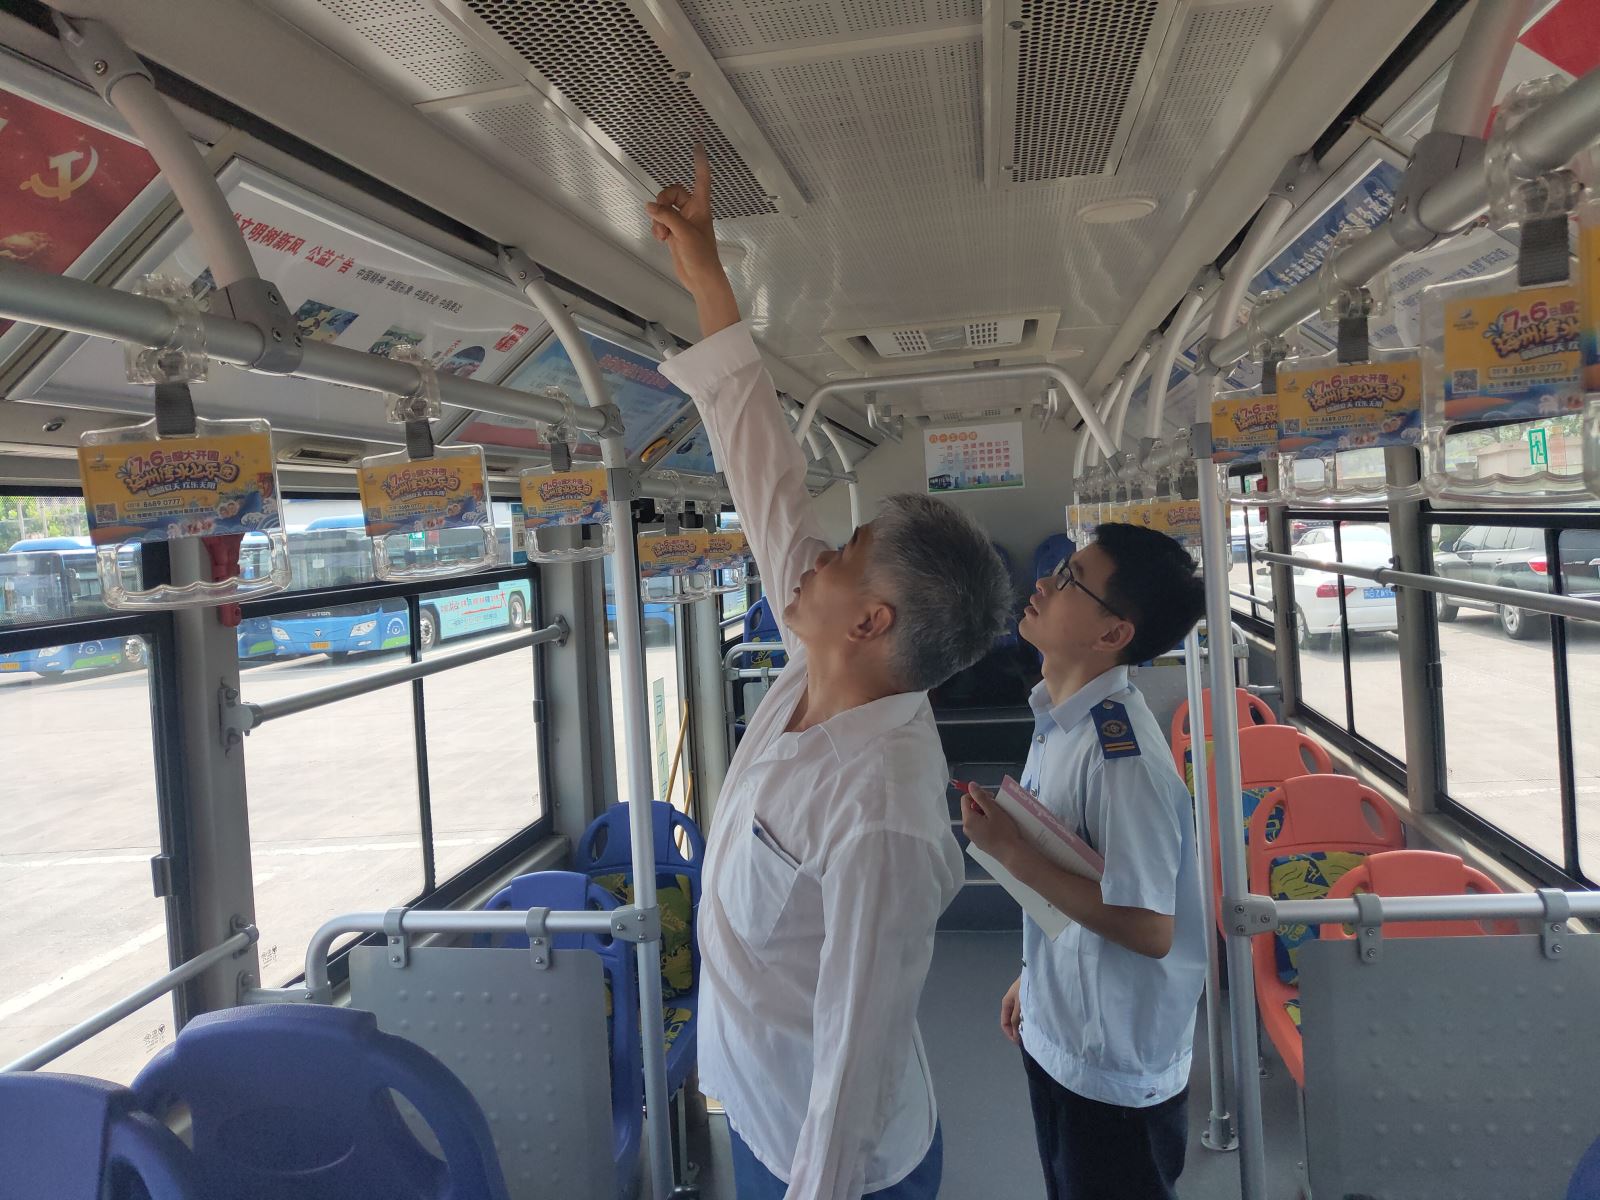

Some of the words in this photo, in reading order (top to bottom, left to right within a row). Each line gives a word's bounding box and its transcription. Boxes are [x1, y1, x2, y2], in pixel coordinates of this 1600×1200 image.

[305, 246, 355, 274] 公益广告
[143, 500, 161, 508] 8689
[163, 498, 181, 506] 0777
